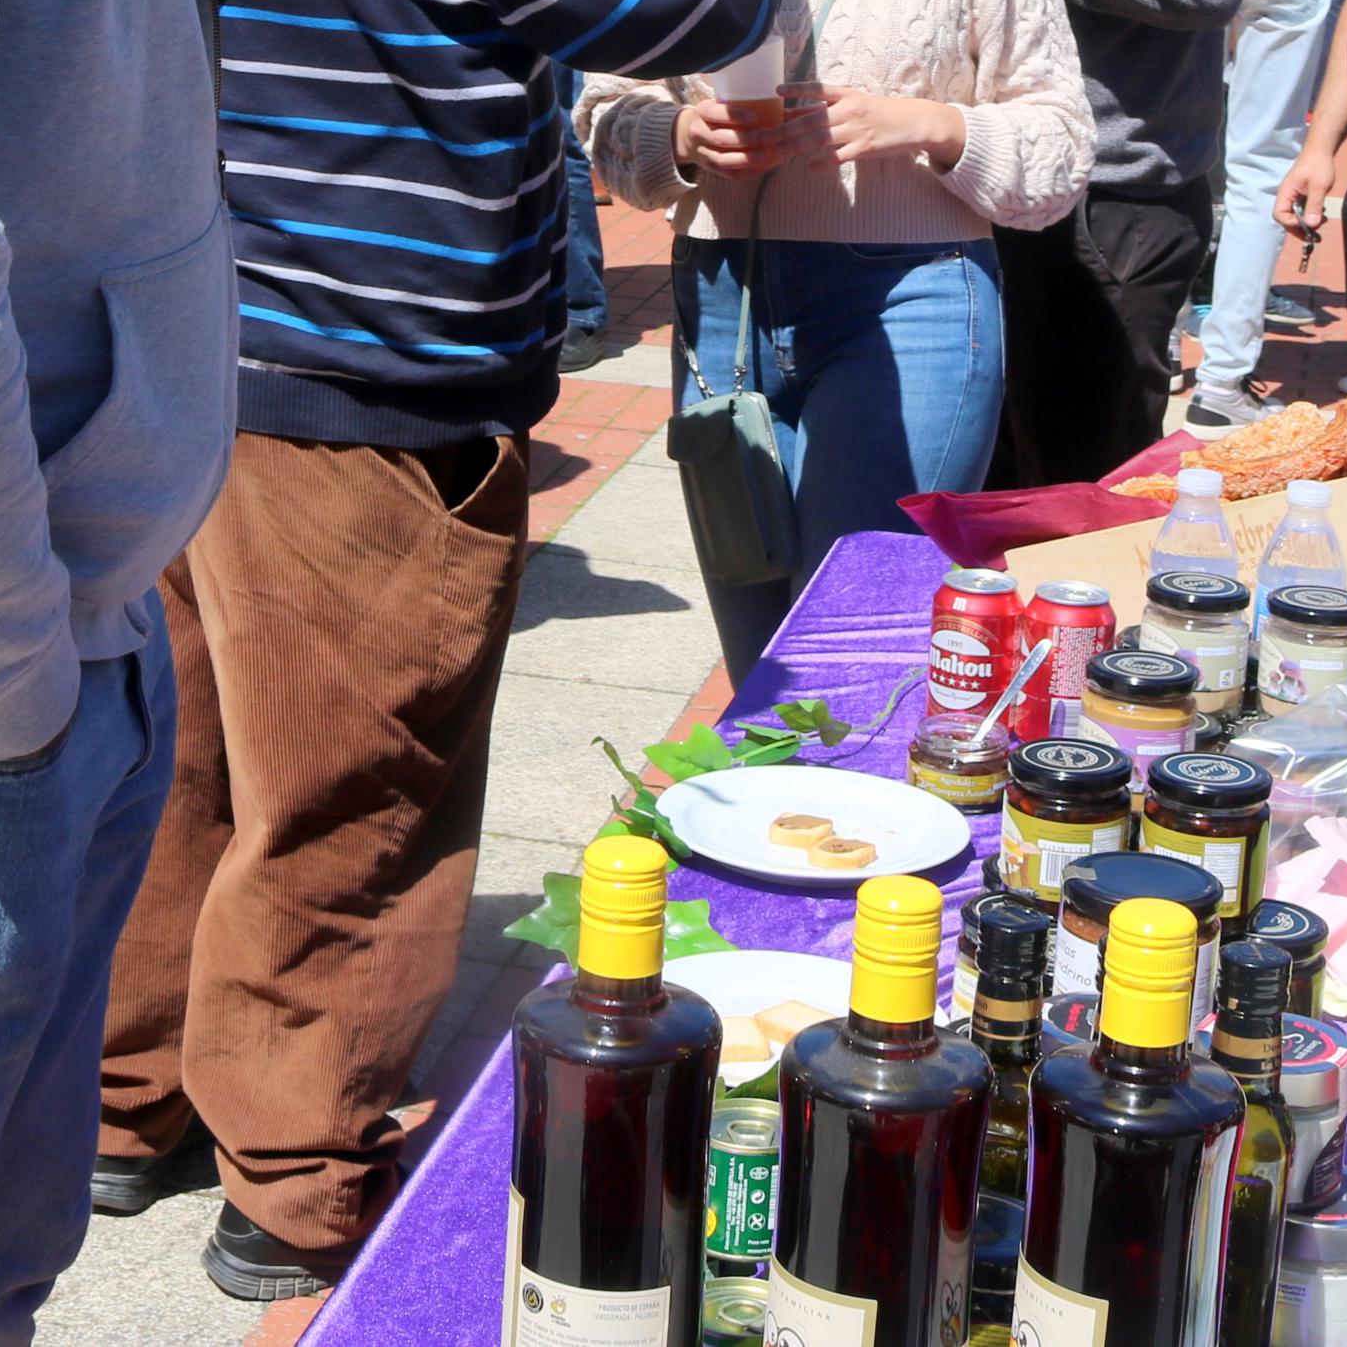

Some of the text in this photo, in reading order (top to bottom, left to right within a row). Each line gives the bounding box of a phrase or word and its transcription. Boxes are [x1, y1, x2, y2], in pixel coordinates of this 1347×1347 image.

[930, 647, 993, 678] Mahou
[598, 1304, 630, 1312] PRODUCTO
[631, 1304, 638, 1312] DE
